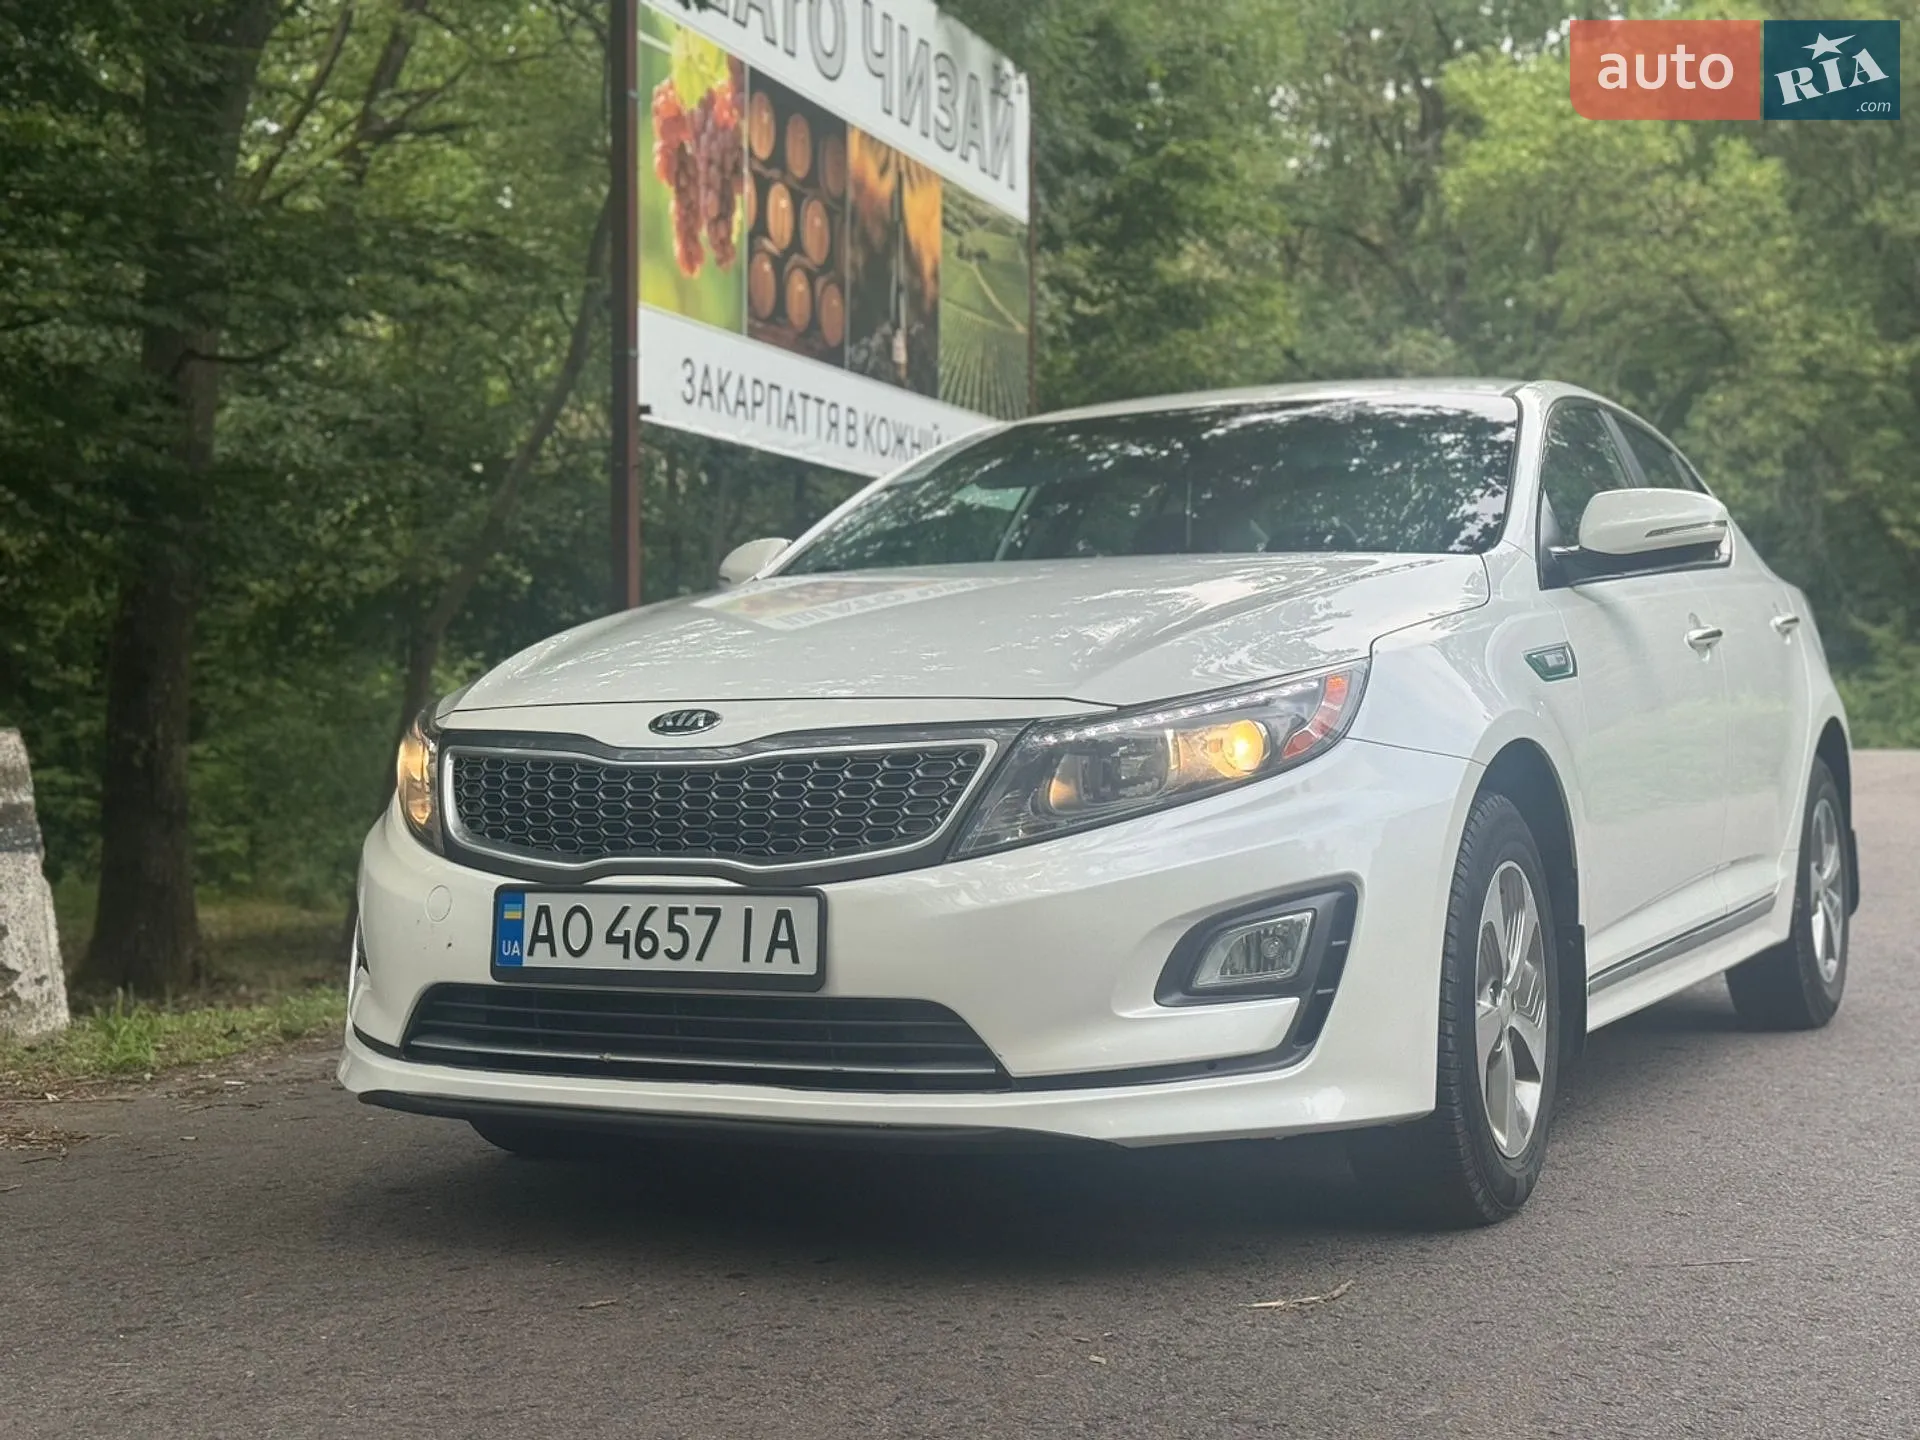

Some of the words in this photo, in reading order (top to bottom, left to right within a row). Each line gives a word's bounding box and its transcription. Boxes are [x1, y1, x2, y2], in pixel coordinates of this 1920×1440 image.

[861, 0, 1016, 191] ЧИЗАЙ
[681, 357, 839, 445] ЗАКАРПАТТЯ
[846, 406, 858, 448] В
[502, 939, 521, 957] UA
[527, 904, 595, 958] AO
[605, 905, 723, 962] 4657
[742, 906, 800, 964] IA
